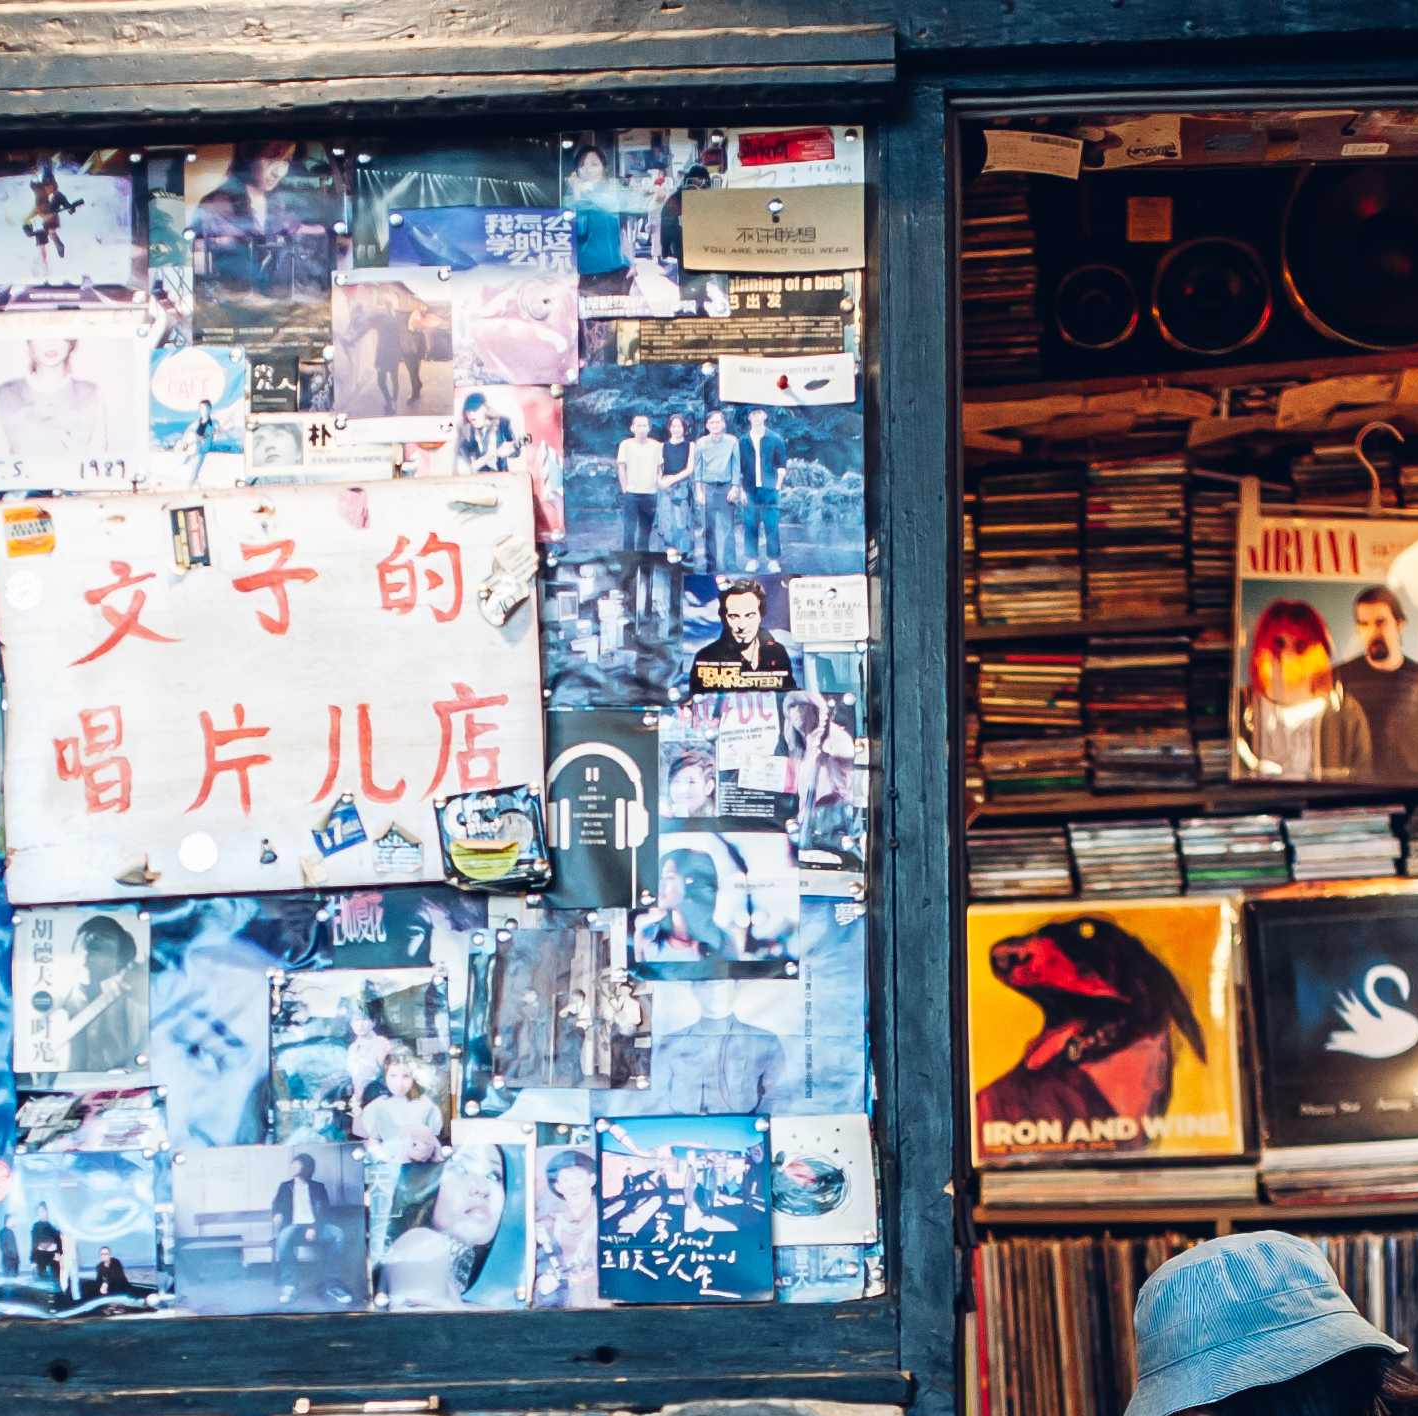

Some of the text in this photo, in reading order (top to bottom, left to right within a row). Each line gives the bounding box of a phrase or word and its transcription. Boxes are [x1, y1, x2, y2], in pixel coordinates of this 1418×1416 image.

[485, 213, 572, 232] 我怎么
[486, 231, 572, 256] 学的这
[736, 226, 817, 244] 不许联想
[703, 244, 850, 254] YOU ARE WHAT YOU WEAR
[785, 276, 800, 291] of
[803, 277, 812, 290] a
[815, 275, 843, 290] bus
[80, 459, 126, 479] 1989
[68, 532, 462, 667] 文子的
[698, 667, 740, 677] BRUCE
[702, 676, 783, 688] SPRINGSTEEN
[53, 682, 509, 818] 唱片儿店
[982, 1113, 1231, 1147] IRON AND WINE
